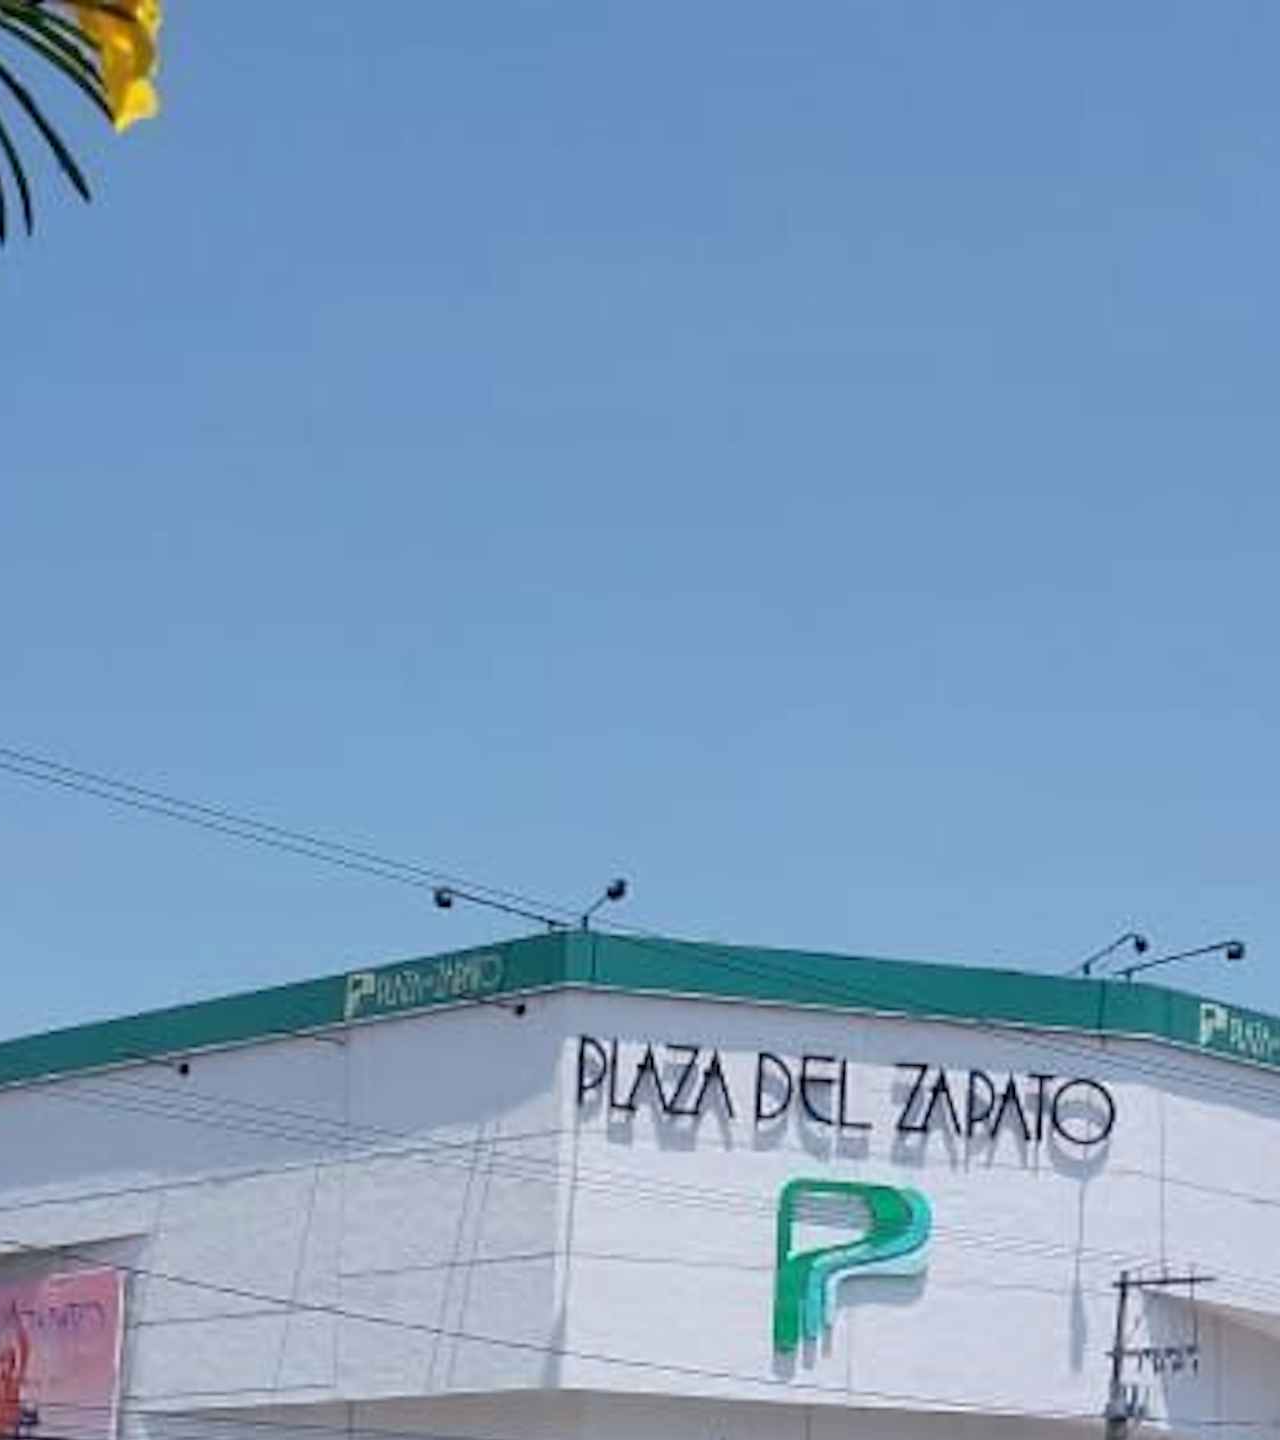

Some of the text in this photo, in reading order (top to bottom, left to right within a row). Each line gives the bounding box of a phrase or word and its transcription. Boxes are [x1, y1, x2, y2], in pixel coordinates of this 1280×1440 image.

[577, 1034, 1117, 1146] PLAZA DEL ZAPATO
